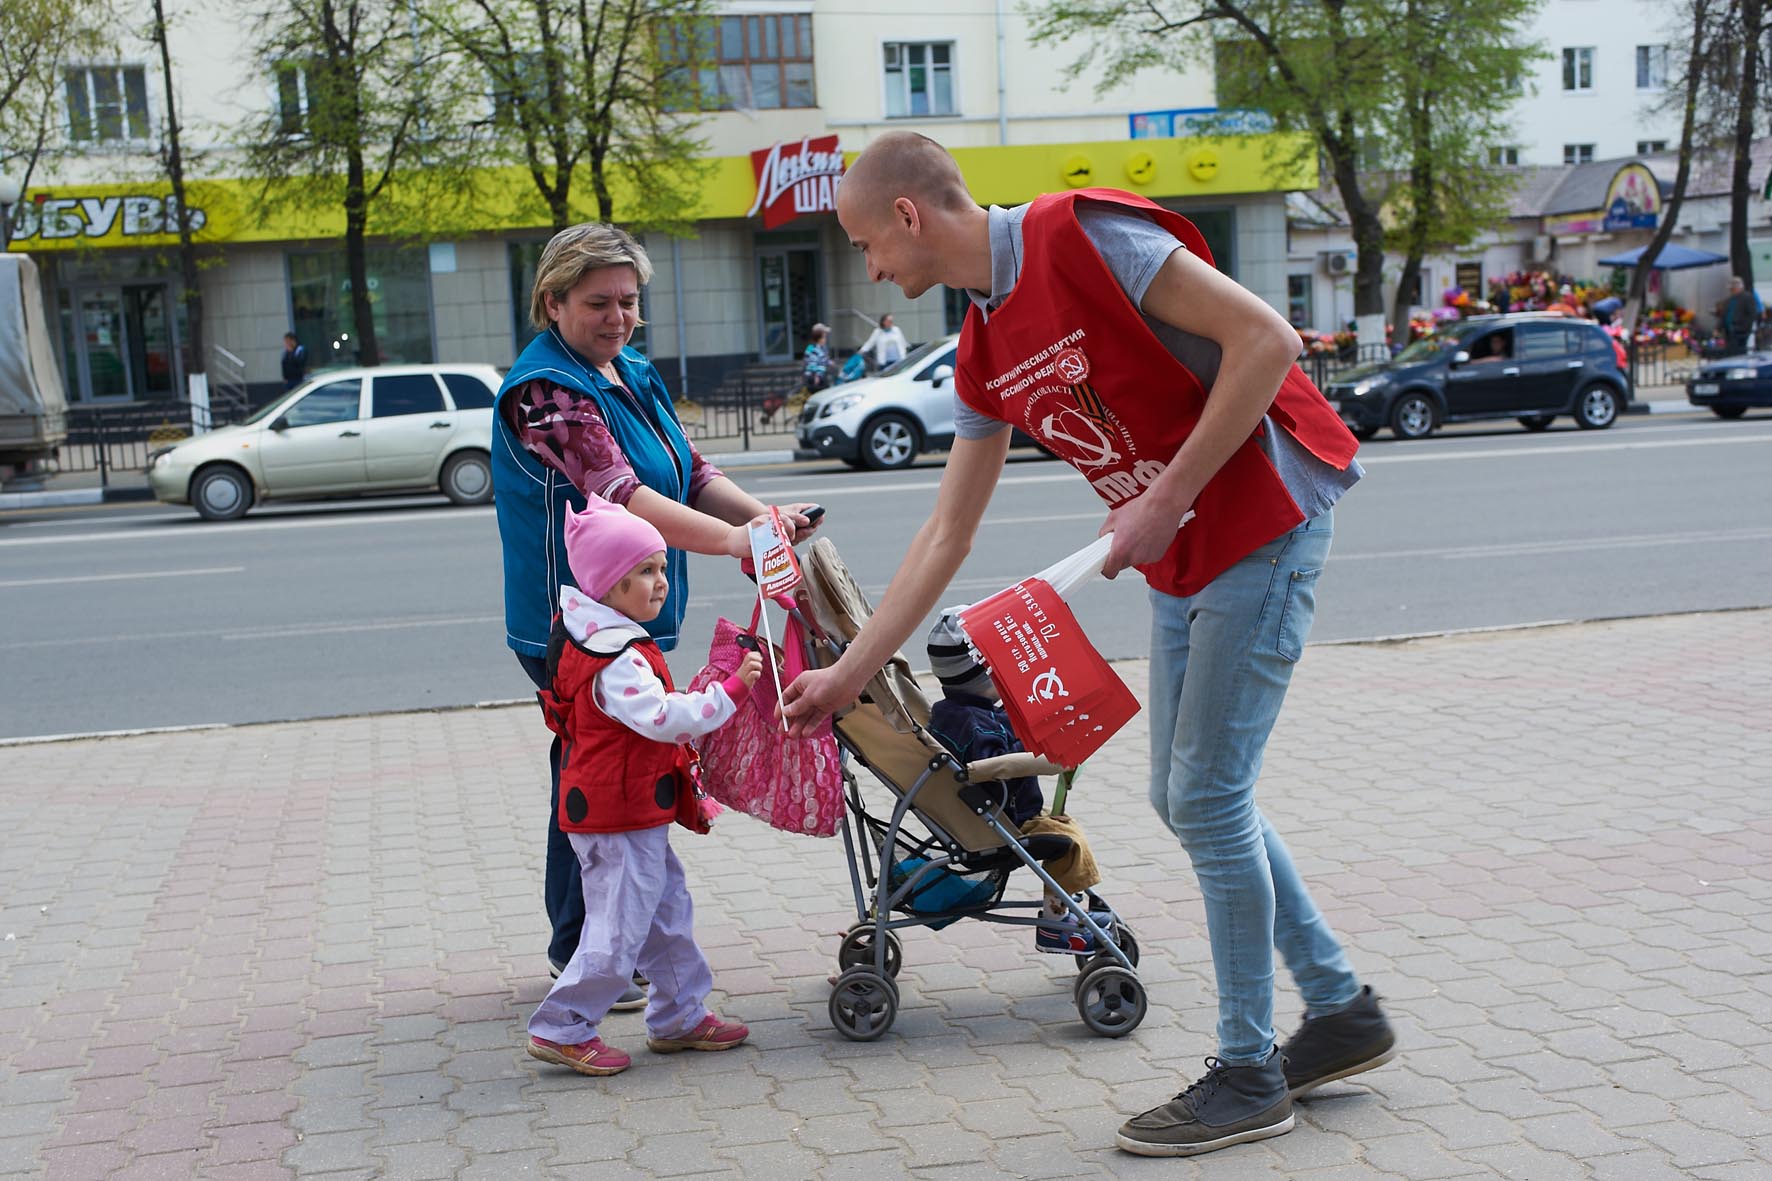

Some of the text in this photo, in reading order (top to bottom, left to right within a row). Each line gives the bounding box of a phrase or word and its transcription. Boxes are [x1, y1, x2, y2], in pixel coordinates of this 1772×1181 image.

[1048, 328, 1086, 355] ПАРТИЯ
[1092, 459, 1167, 506] ПРФ
[1040, 623, 1060, 643] 79
[1017, 660, 1031, 673] 150
